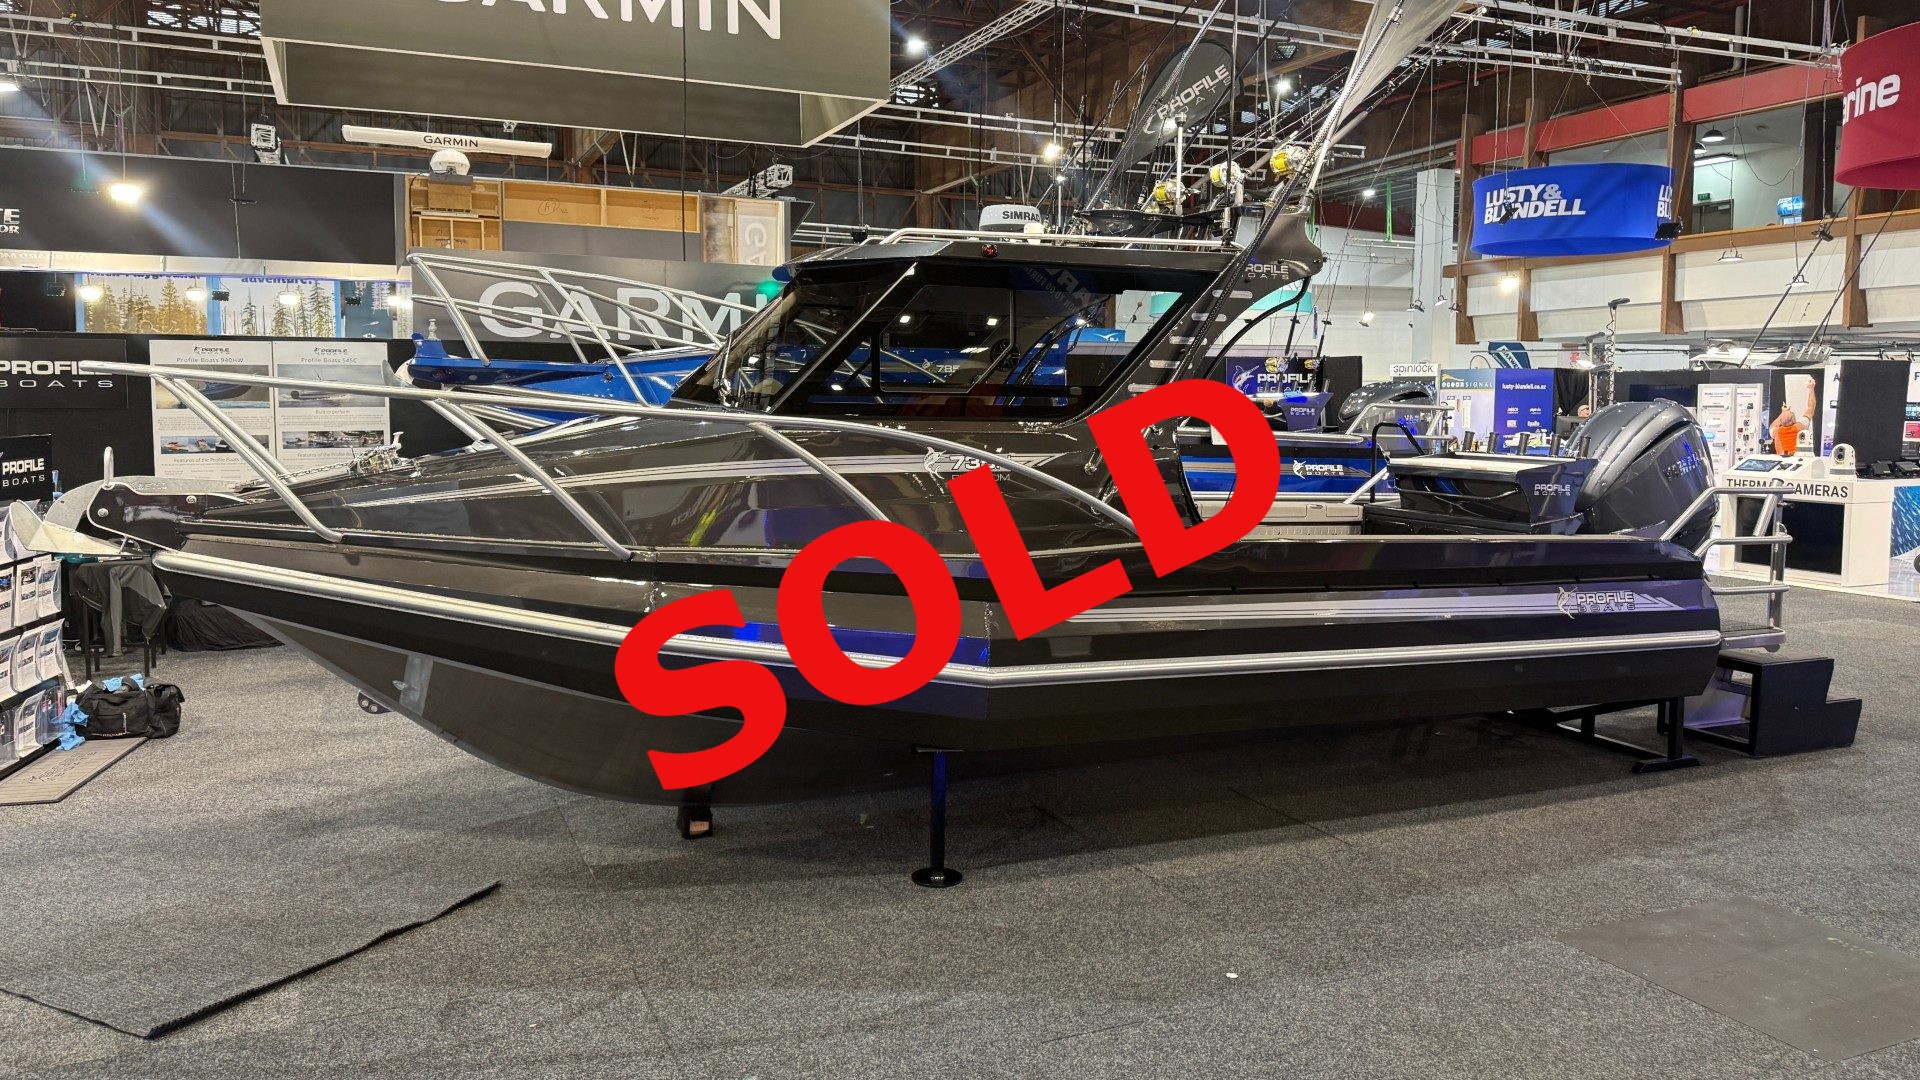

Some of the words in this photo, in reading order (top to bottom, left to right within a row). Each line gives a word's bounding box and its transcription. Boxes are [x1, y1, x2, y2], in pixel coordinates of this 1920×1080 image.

[1157, 64, 1229, 119] PROFILE
[423, 135, 479, 148] GARMIN
[1484, 198, 1586, 225] BLNDELL
[1245, 263, 1289, 274] ROFILE
[1242, 272, 1289, 280] OATS
[478, 281, 769, 342] GARM
[2, 458, 45, 475] PROFILE
[1305, 464, 1344, 472] PROFILE
[2, 474, 46, 487] BOATS
[1577, 591, 1634, 604] PROFILE
[1577, 603, 1635, 612] BOATS
